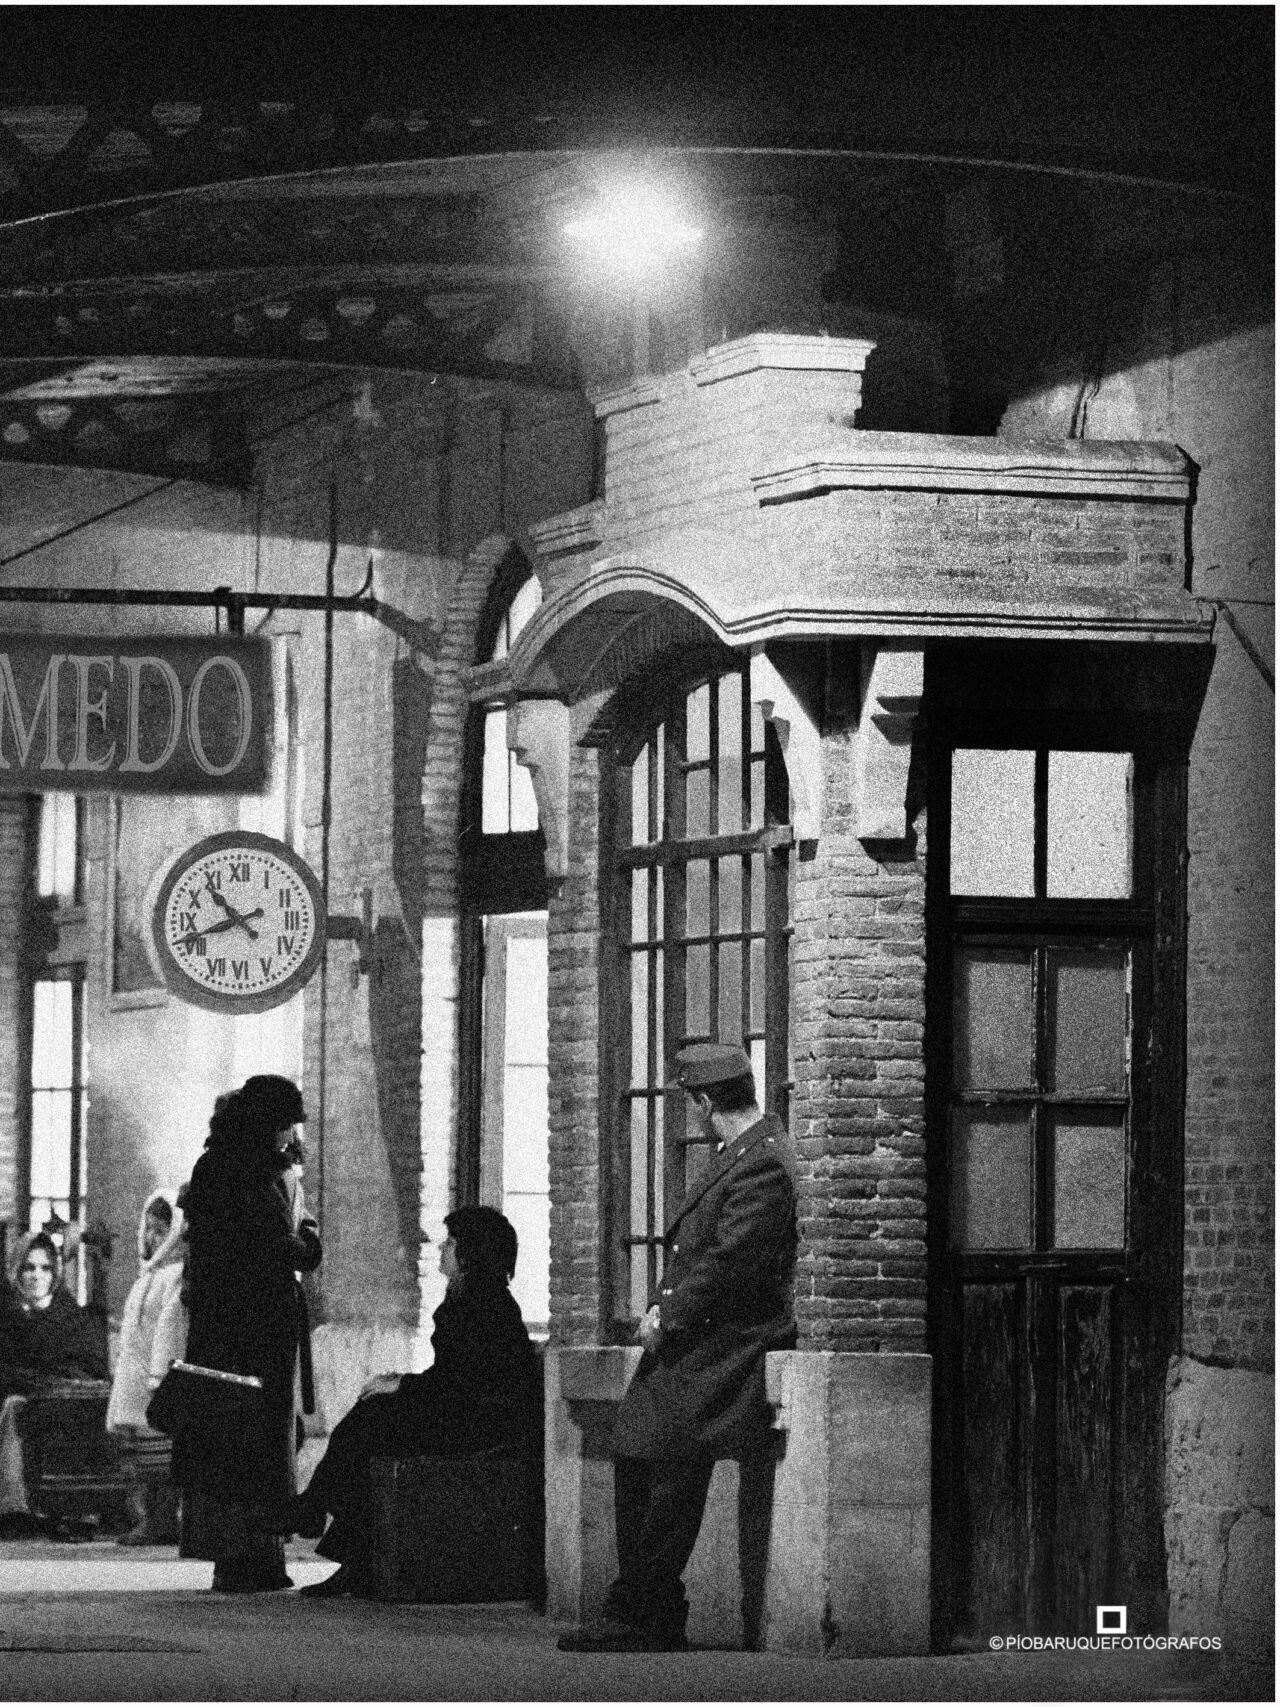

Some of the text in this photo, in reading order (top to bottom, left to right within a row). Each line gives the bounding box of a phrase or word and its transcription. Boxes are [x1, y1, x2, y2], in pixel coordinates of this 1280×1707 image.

[205, 871, 221, 890] XI
[229, 863, 250, 882] XII
[264, 870, 269, 889] I
[189, 890, 201, 909] X
[279, 889, 291, 908] II
[179, 912, 197, 931] IX
[284, 911, 300, 930] III
[278, 936, 295, 955] IV
[207, 958, 226, 977] VII
[232, 960, 249, 980] VI
[260, 958, 272, 977] V
